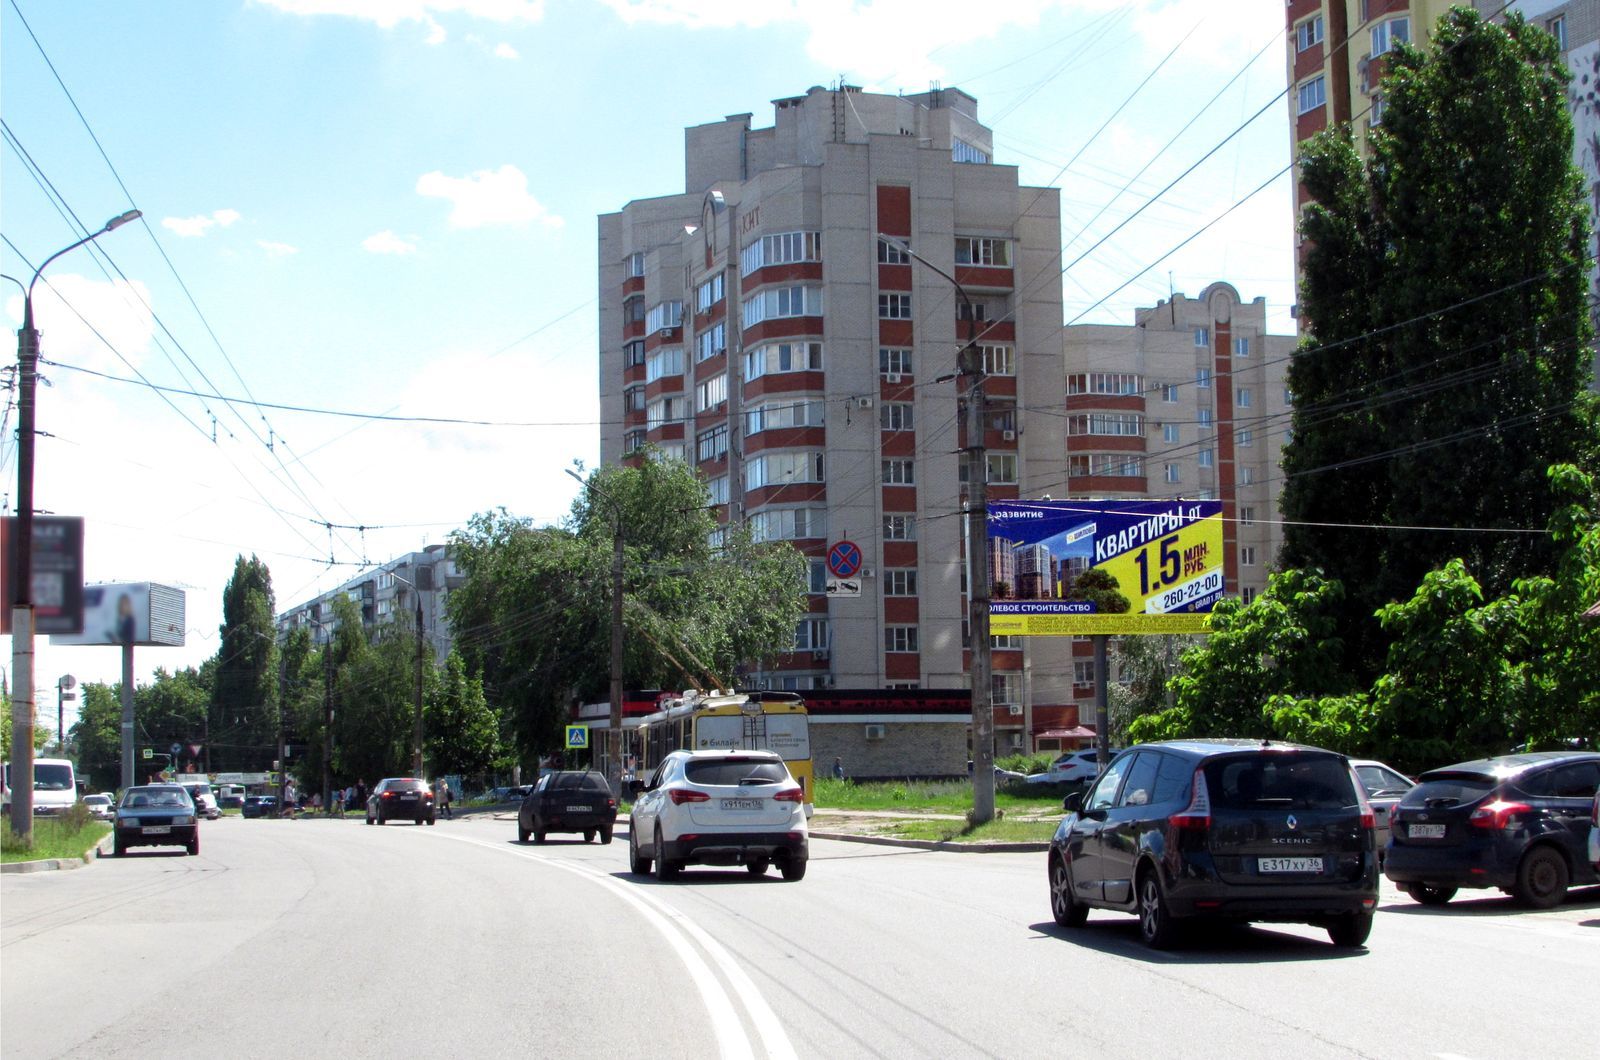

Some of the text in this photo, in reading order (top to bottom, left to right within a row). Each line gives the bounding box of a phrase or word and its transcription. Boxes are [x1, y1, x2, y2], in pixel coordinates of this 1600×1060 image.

[1095, 505, 1183, 562] КВАРТИРЫ
[1134, 534, 1182, 596] 1.5
[1183, 541, 1210, 563] МЛН.
[1184, 556, 1207, 577] РУБ.
[1163, 573, 1218, 609] 260-22-00
[989, 604, 1091, 612] ОЛЕВОЕ СТРОИТЕЛЬСТВО
